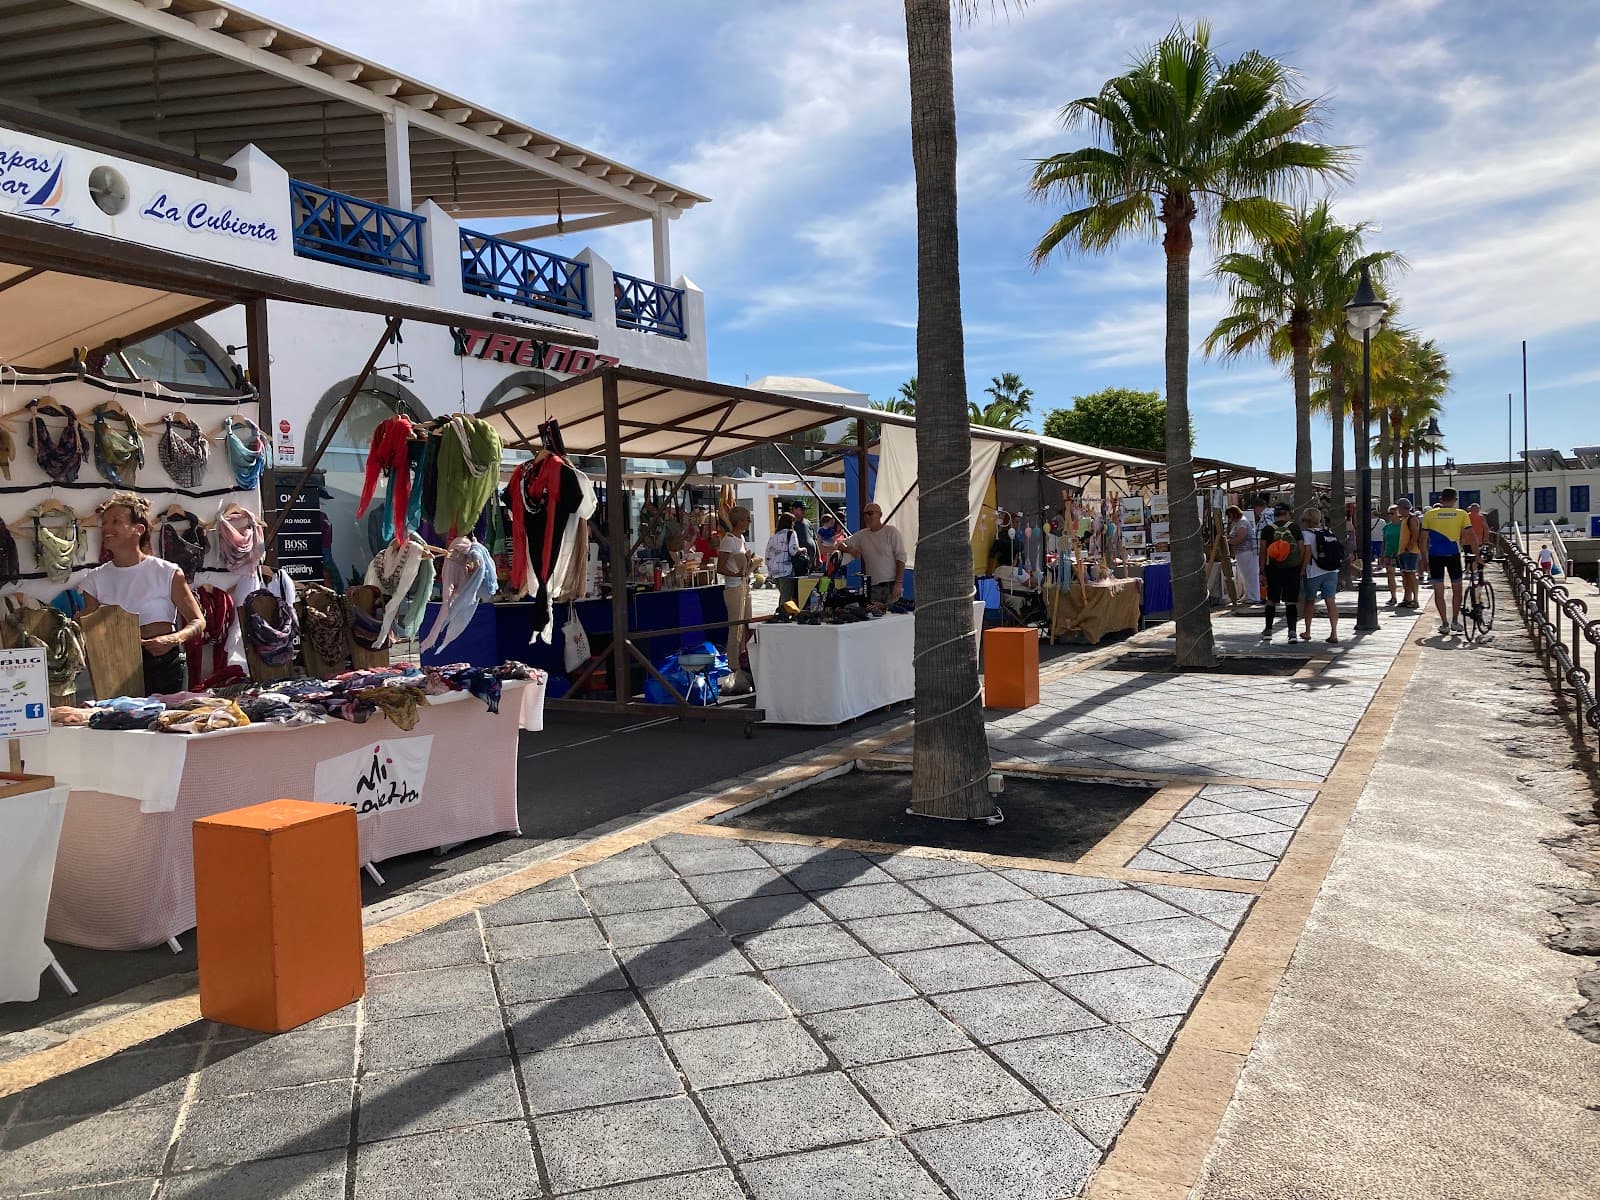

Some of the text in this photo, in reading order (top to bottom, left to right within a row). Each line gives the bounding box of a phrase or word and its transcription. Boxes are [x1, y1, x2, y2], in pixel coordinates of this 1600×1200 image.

[143, 193, 278, 241] La Cubierta
[284, 539, 308, 549] BOSS
